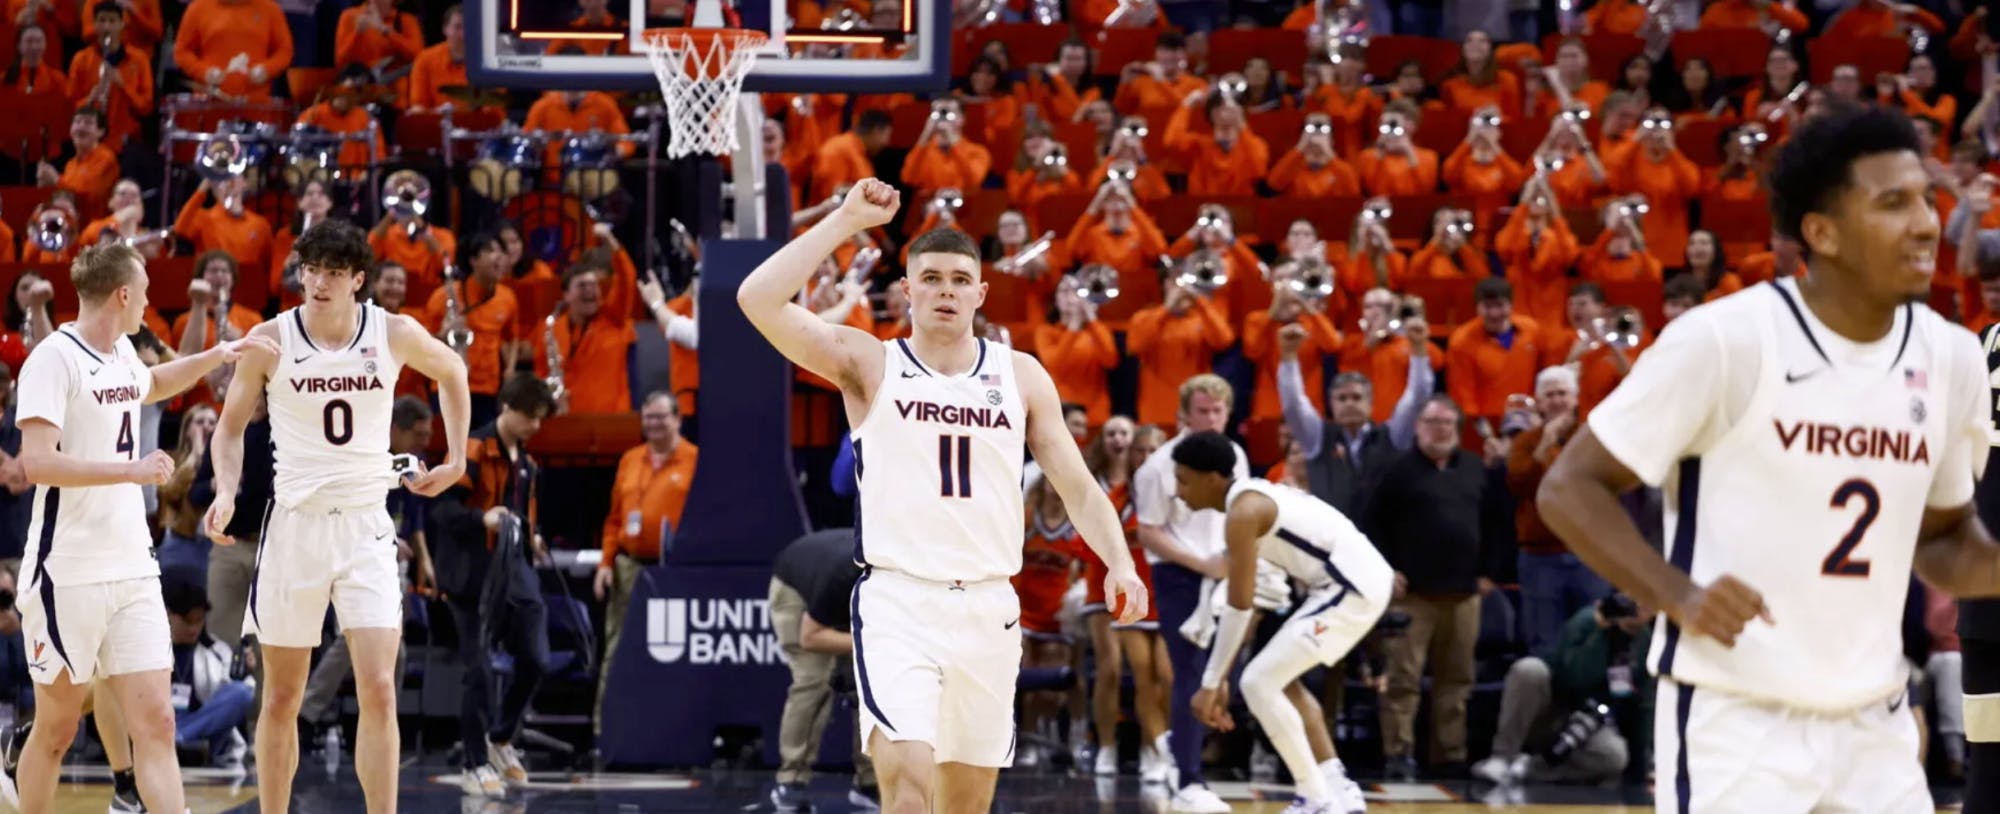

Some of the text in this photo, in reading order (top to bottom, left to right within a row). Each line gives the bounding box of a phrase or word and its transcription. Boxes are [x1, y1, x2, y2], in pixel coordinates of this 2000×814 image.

[290, 375, 384, 393] VIRGINIA
[116, 410, 134, 461] 4
[323, 398, 353, 446] 0
[894, 399, 1012, 430] VIRGINIA
[1773, 418, 1930, 465] VIRGINIA
[939, 434, 972, 498] 11
[1821, 477, 1881, 577] 2
[689, 598, 770, 630] UNIT
[689, 633, 791, 664] BANK
